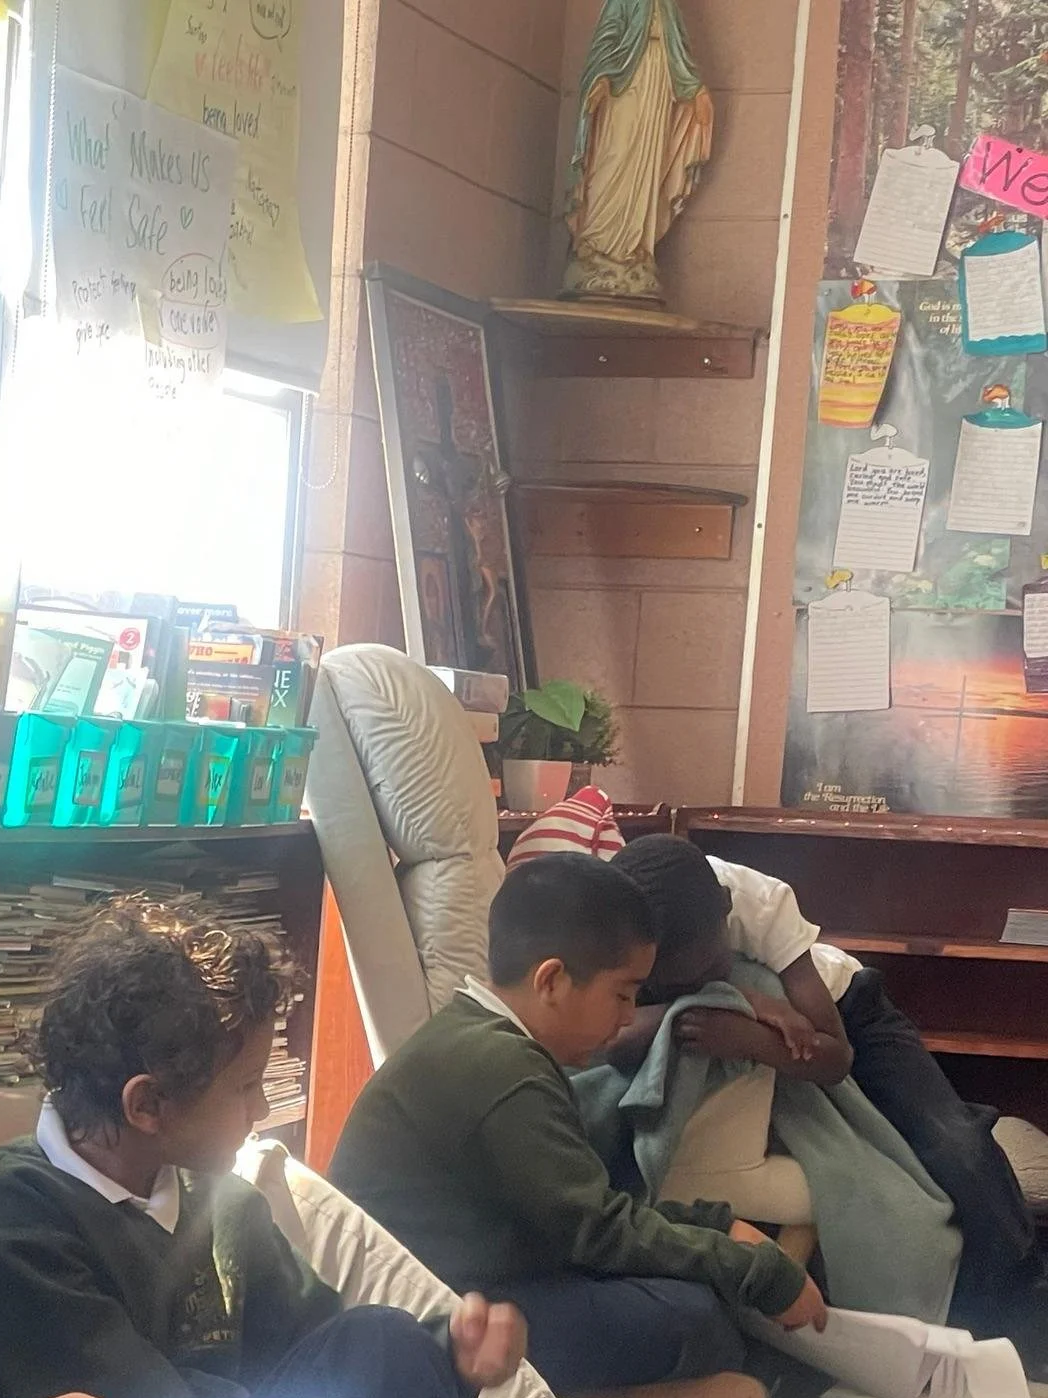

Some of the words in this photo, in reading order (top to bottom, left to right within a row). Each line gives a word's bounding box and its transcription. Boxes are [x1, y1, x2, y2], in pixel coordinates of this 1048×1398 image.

[67, 110, 110, 170] What
[130, 130, 182, 185] Makes
[978, 140, 1048, 207] We
[126, 193, 168, 255] Safe
